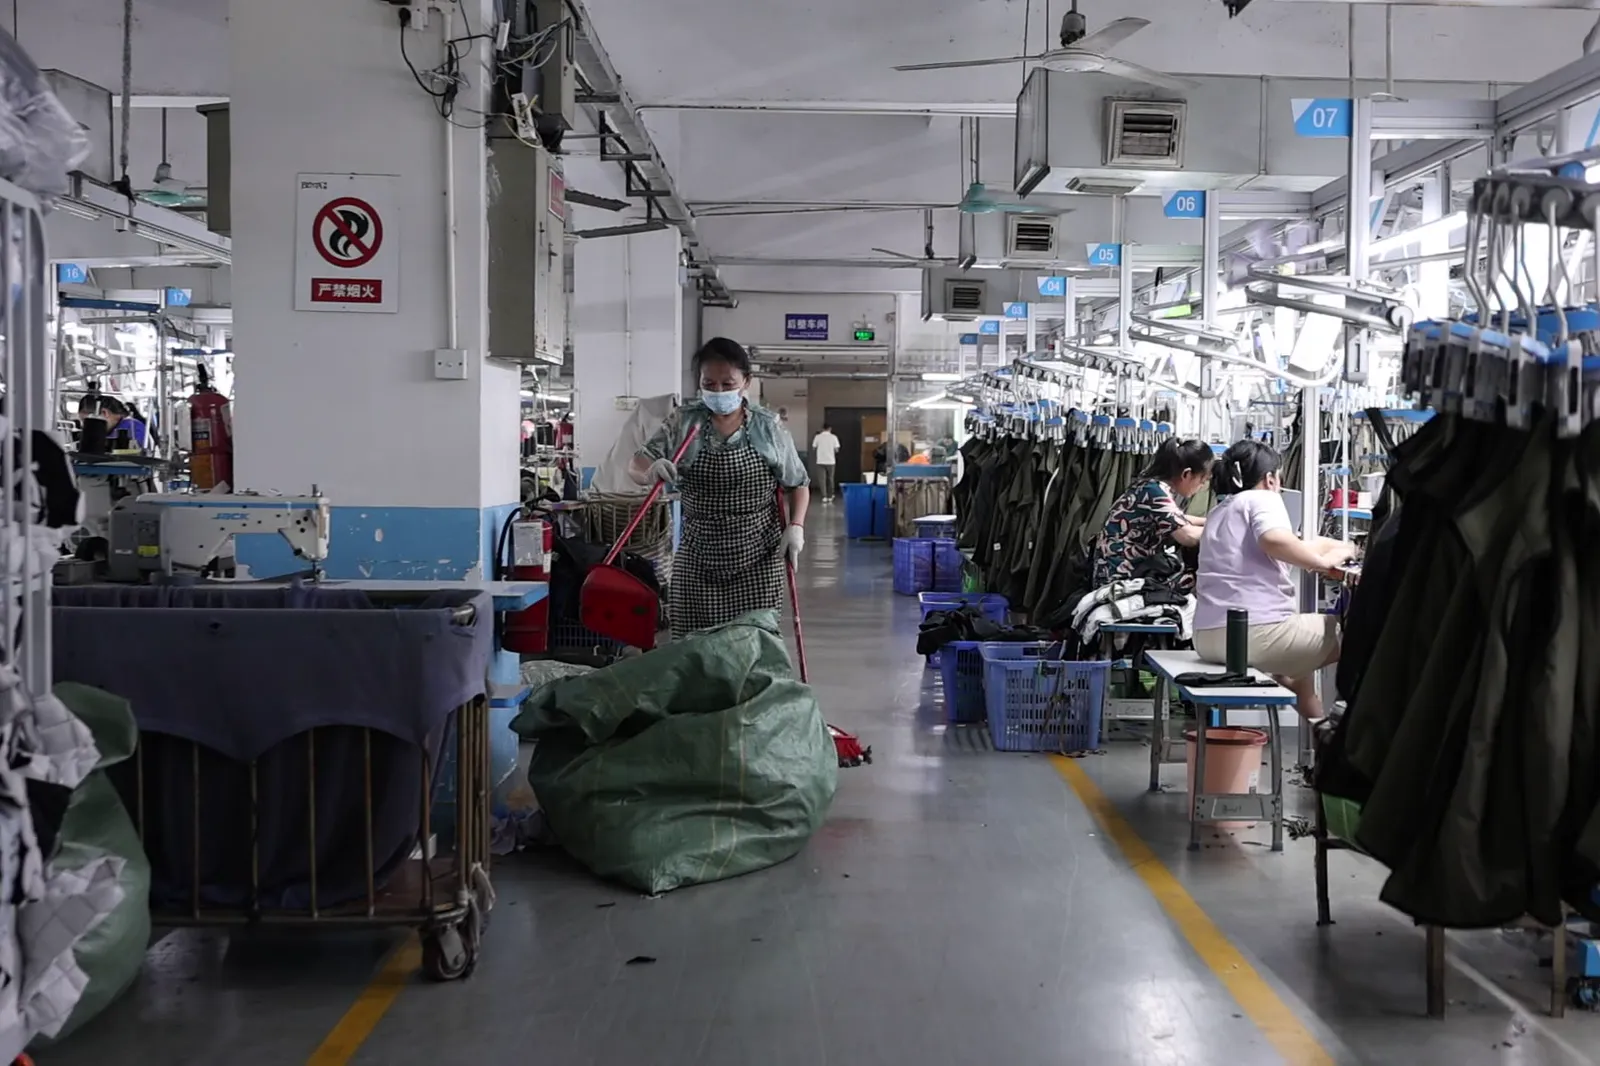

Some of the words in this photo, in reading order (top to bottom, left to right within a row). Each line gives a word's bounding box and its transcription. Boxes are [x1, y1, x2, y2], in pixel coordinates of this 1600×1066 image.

[1312, 108, 1338, 128] 07
[1176, 196, 1196, 212] 06
[1098, 248, 1114, 261] 05
[66, 268, 79, 278] 16
[318, 283, 375, 298] 严禁烟火
[1047, 280, 1060, 291] 04
[173, 292, 184, 302] 17
[1011, 305, 1022, 315] 03
[211, 512, 250, 521] JACK
